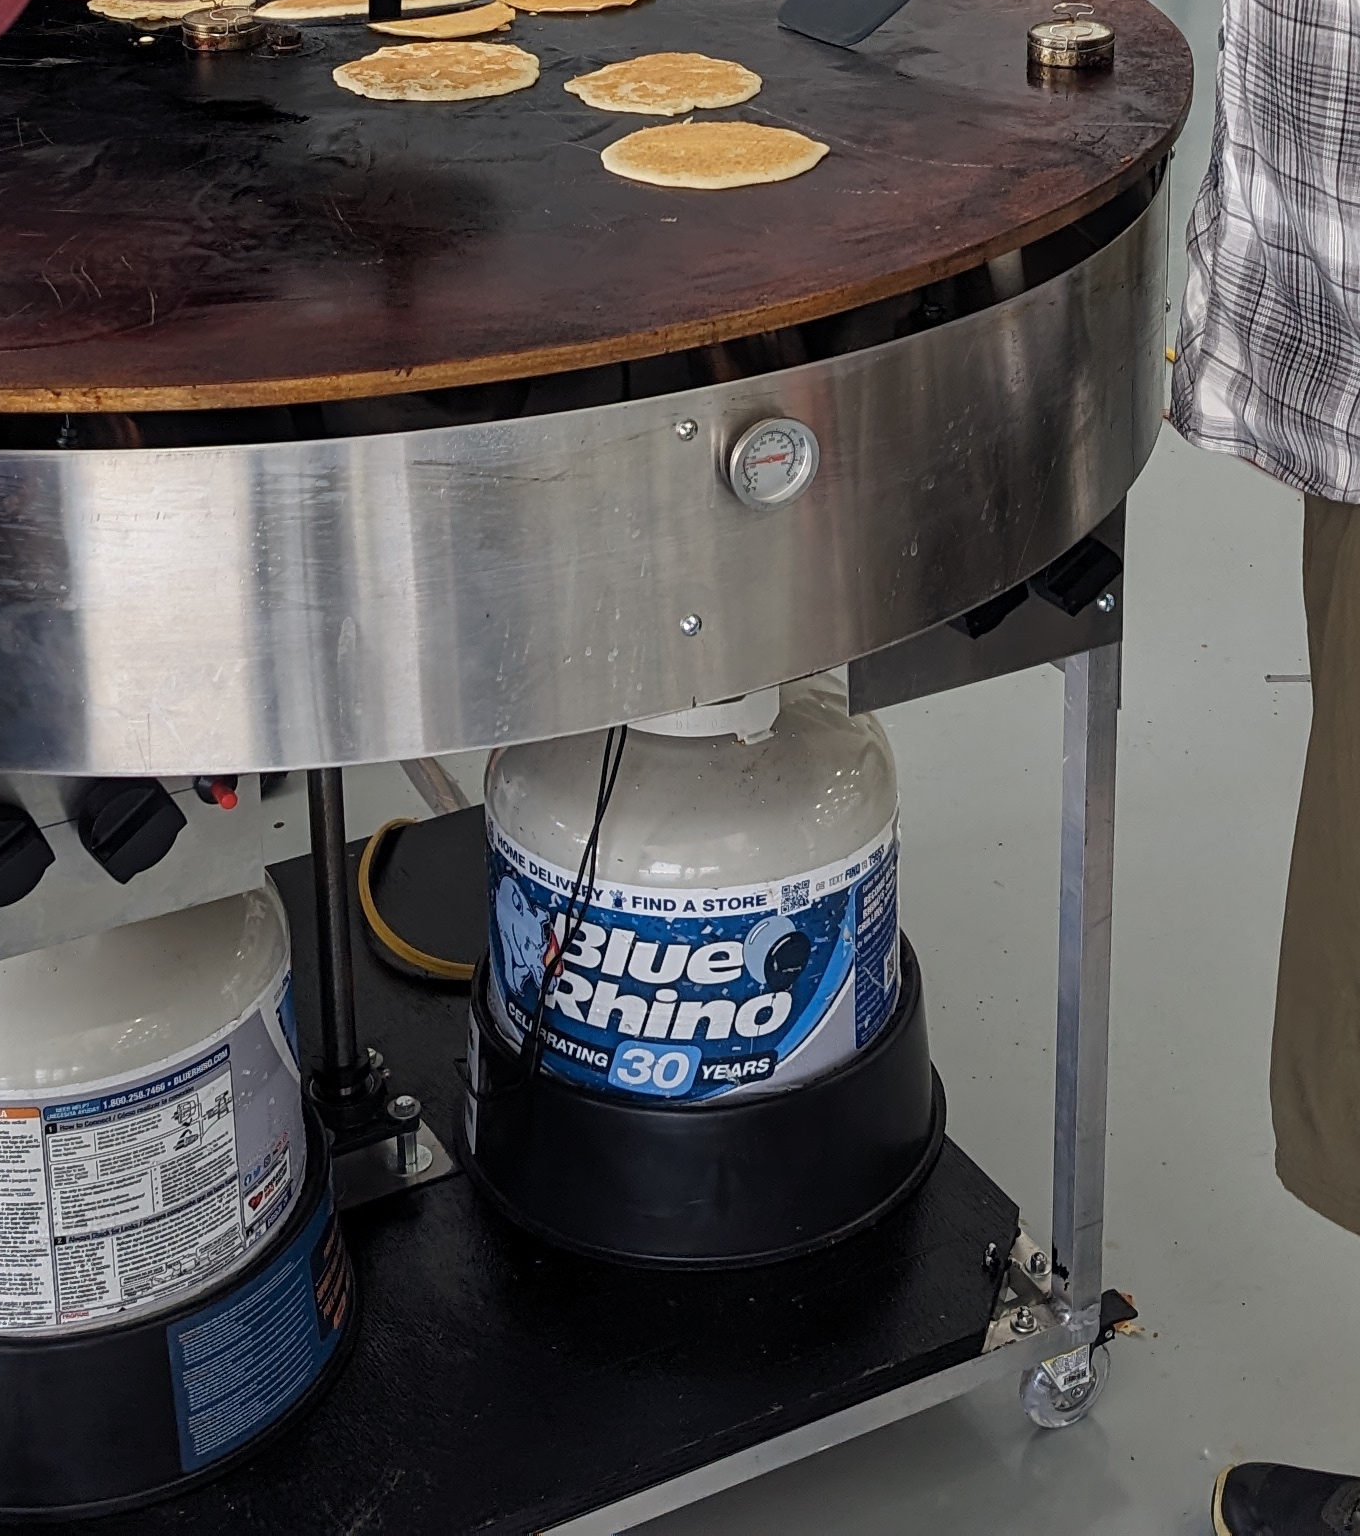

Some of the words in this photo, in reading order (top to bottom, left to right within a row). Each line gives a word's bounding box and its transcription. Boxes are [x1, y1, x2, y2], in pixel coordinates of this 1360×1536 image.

[496, 833, 526, 869] HOME
[528, 860, 605, 902] DELIVERY
[631, 895, 676, 912] FIND
[682, 900, 697, 913] A
[702, 893, 769, 912] STORE
[828, 872, 844, 887] TEXT
[553, 911, 744, 985] Blue
[544, 969, 793, 1041] Rhino
[617, 1047, 691, 1090] 30
[701, 1057, 771, 1082] YEARS
